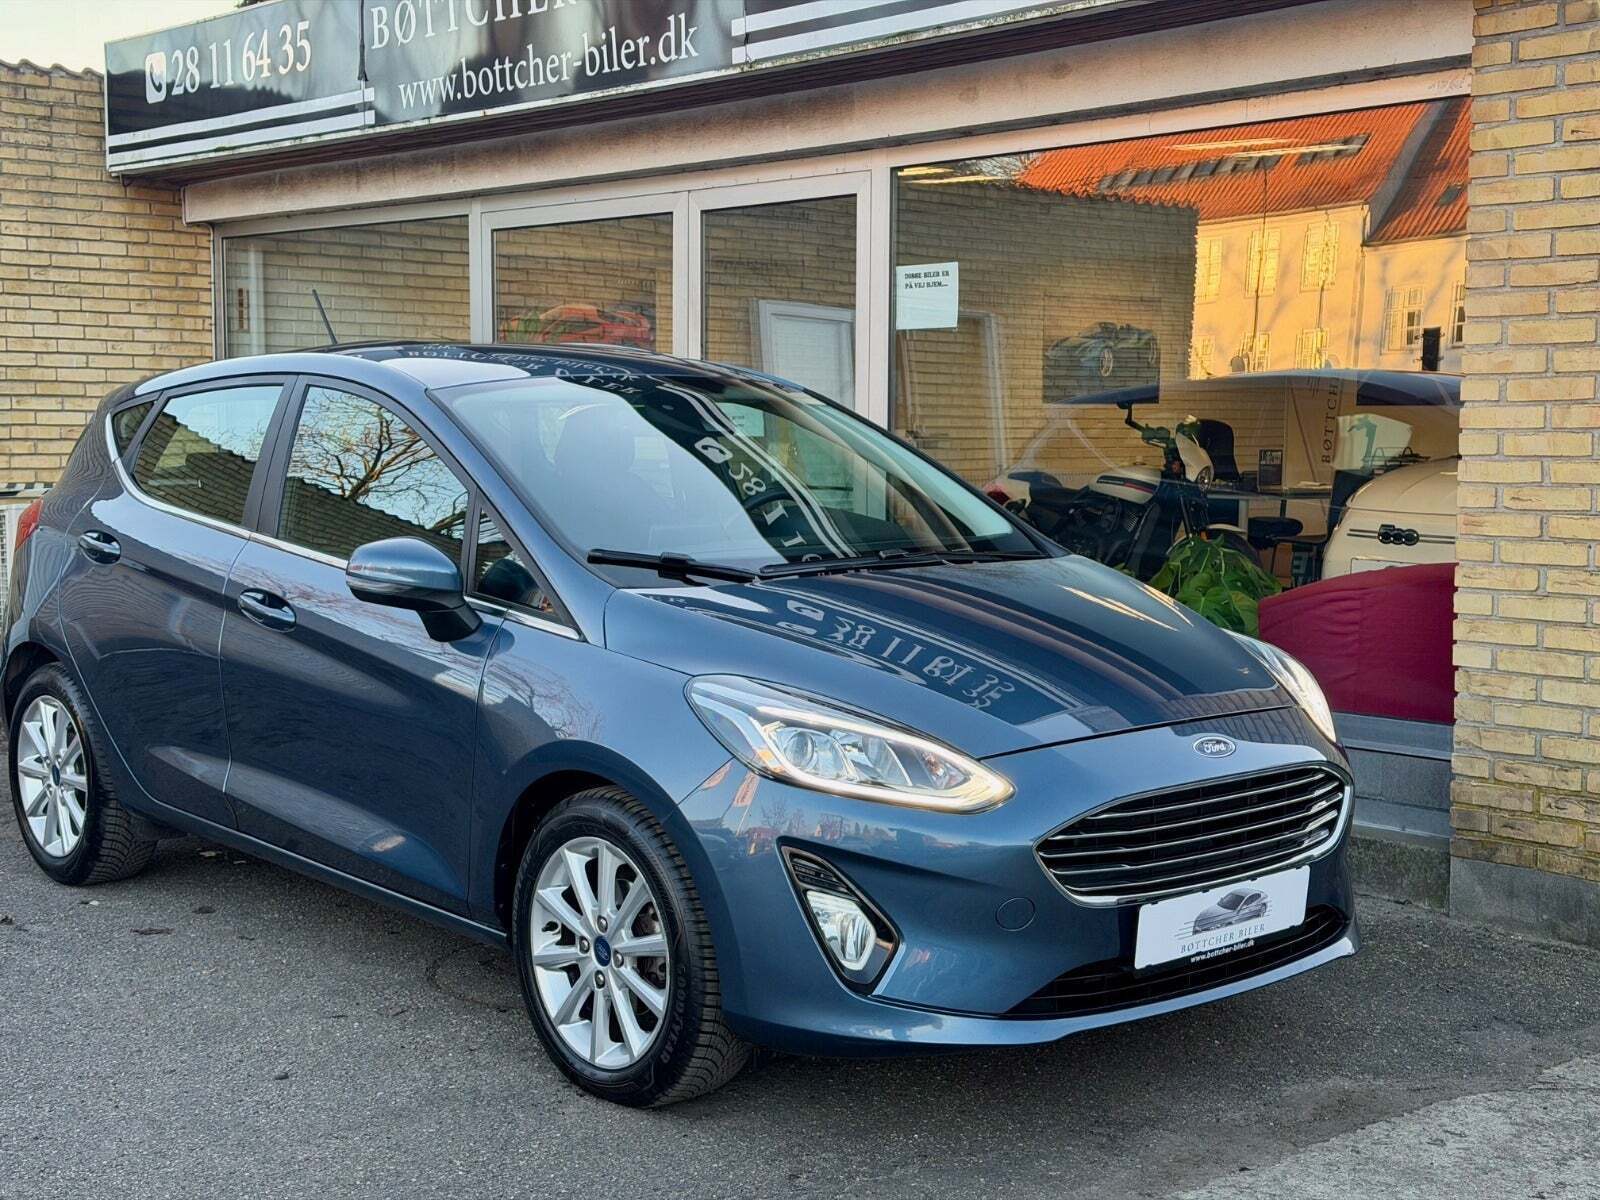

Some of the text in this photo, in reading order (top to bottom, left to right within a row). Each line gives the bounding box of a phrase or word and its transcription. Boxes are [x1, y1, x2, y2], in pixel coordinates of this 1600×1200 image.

[371, 0, 577, 49] BØTTC
[171, 20, 312, 97] 28 11 64 35
[399, 13, 699, 110] www.bottcher-biler.dk
[1238, 923, 1266, 938] BILER
